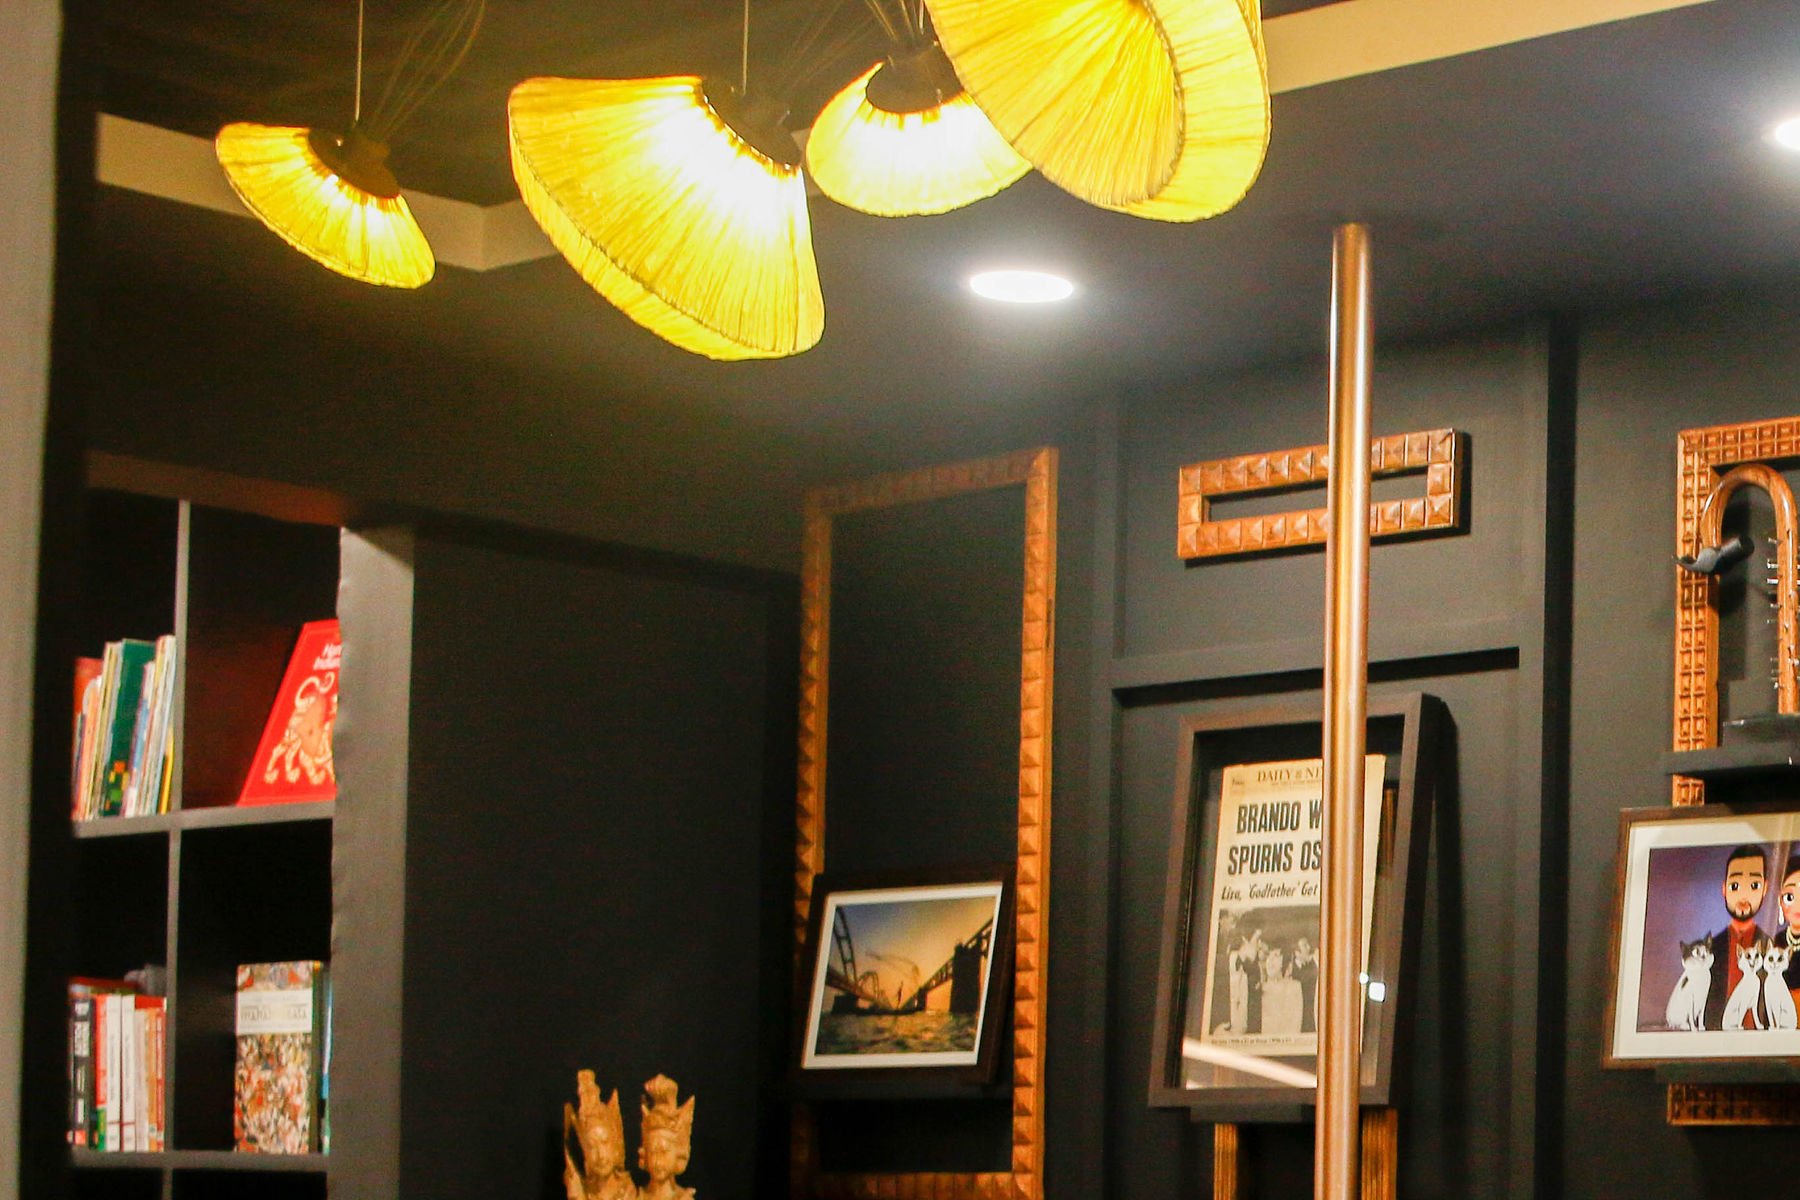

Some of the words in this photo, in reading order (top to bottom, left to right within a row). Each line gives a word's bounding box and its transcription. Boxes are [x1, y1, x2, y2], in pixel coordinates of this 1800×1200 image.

[1257, 769, 1290, 782] DAILY
[1236, 801, 1301, 834] BRANDO
[1227, 841, 1294, 876] SPURNS
[1300, 840, 1322, 872] OS
